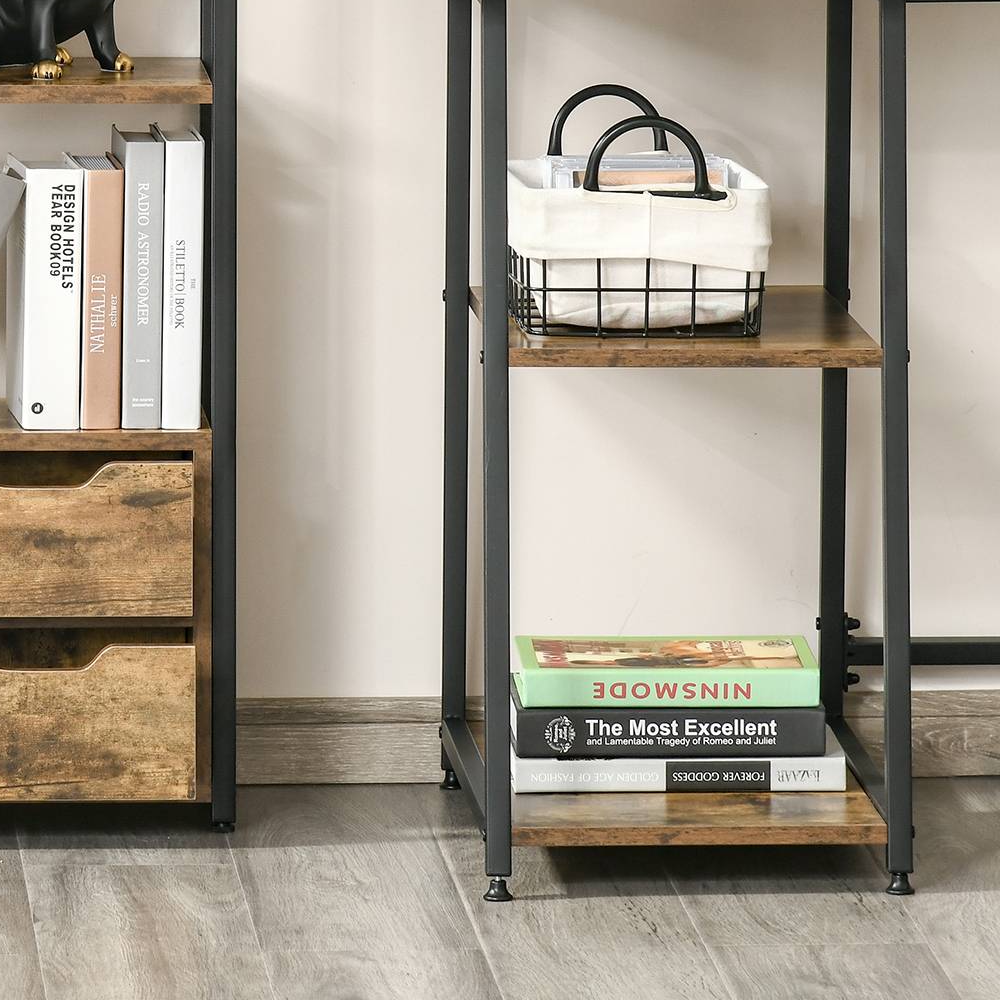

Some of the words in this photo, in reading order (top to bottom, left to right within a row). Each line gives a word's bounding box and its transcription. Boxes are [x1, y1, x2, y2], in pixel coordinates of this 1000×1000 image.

[51, 185, 63, 218] YEAR
[64, 185, 75, 233] DESIGN
[137, 182, 149, 226] RADIO
[62, 239, 74, 290] HOTELS
[175, 239, 186, 292] STILETTO
[137, 231, 149, 326] ASTRONOMER
[90, 274, 106, 353] NATHALIE
[175, 298, 185, 329] BOOK
[593, 682, 751, 699] NINSMODE
[586, 719, 624, 736] The
[629, 719, 678, 736] Most
[684, 719, 777, 736] Excellent
[586, 737, 602, 746] and
[605, 737, 654, 746] Lamentable
[657, 737, 690, 748] Tragedy
[692, 737, 701, 746] of
[703, 737, 733, 746] Romeo
[735, 737, 751, 746] and
[753, 737, 776, 746] Juliet
[530, 773, 574, 782] FASHION
[578, 773, 591, 782] OF
[594, 773, 612, 782] AGE
[616, 773, 660, 782] GOLDEN
[672, 771, 719, 782] GODDESS
[722, 771, 765, 782] FOREVER
